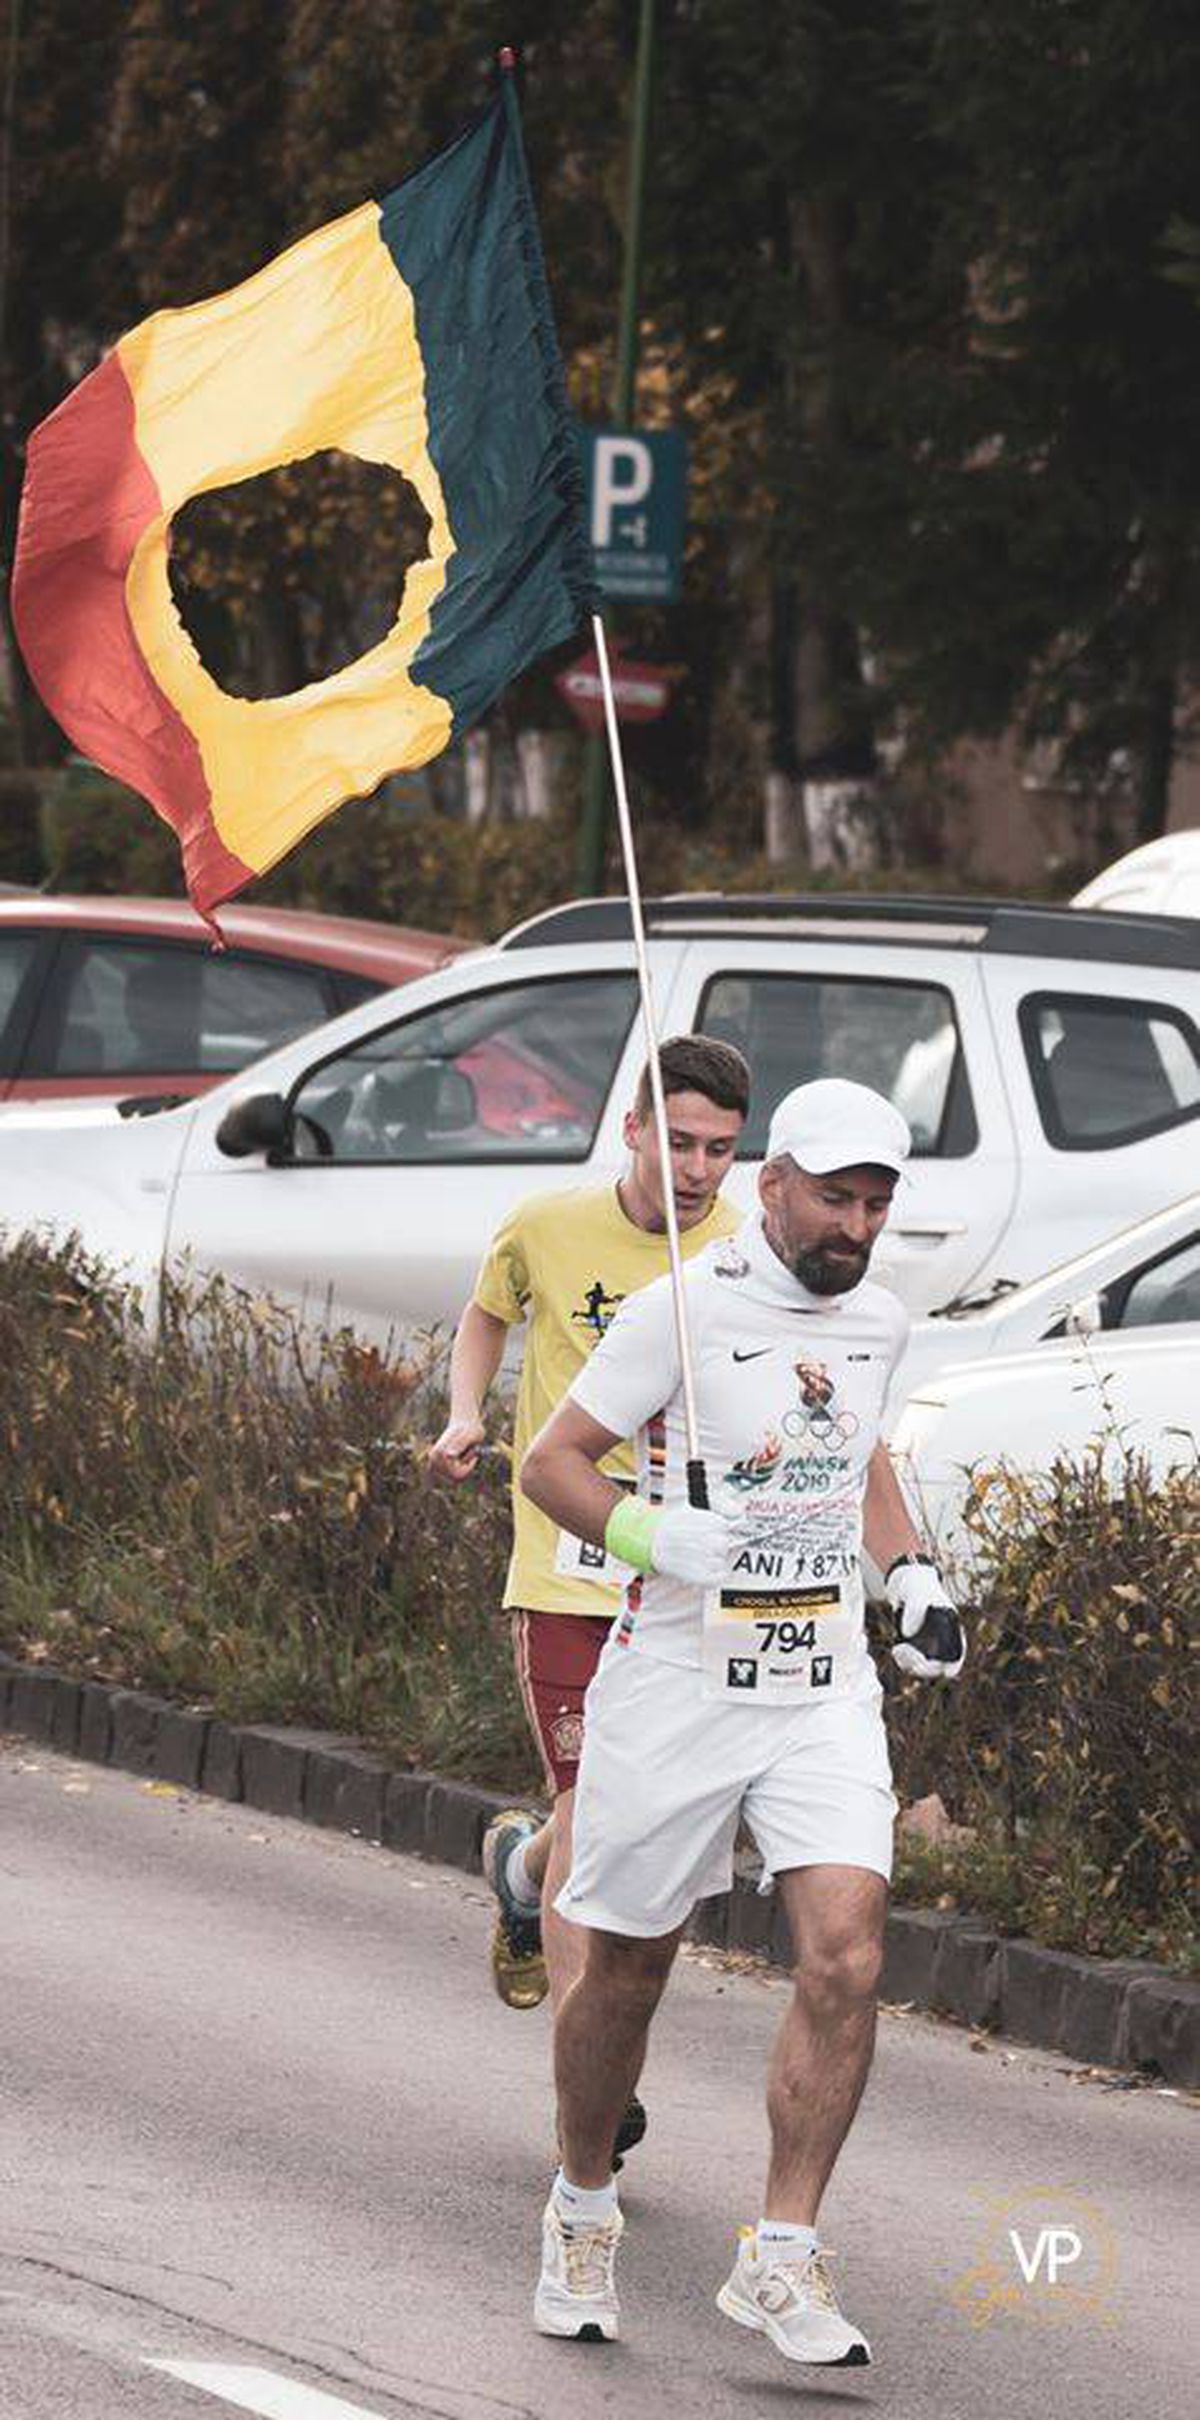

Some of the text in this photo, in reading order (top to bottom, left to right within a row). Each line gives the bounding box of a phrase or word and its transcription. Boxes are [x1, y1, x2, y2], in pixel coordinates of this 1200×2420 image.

[592, 435, 653, 547] P
[783, 1452, 850, 1472] MINSK
[780, 1472, 830, 1492] 2019
[732, 1551, 783, 1577] ANI
[755, 1621, 816, 1653] 794
